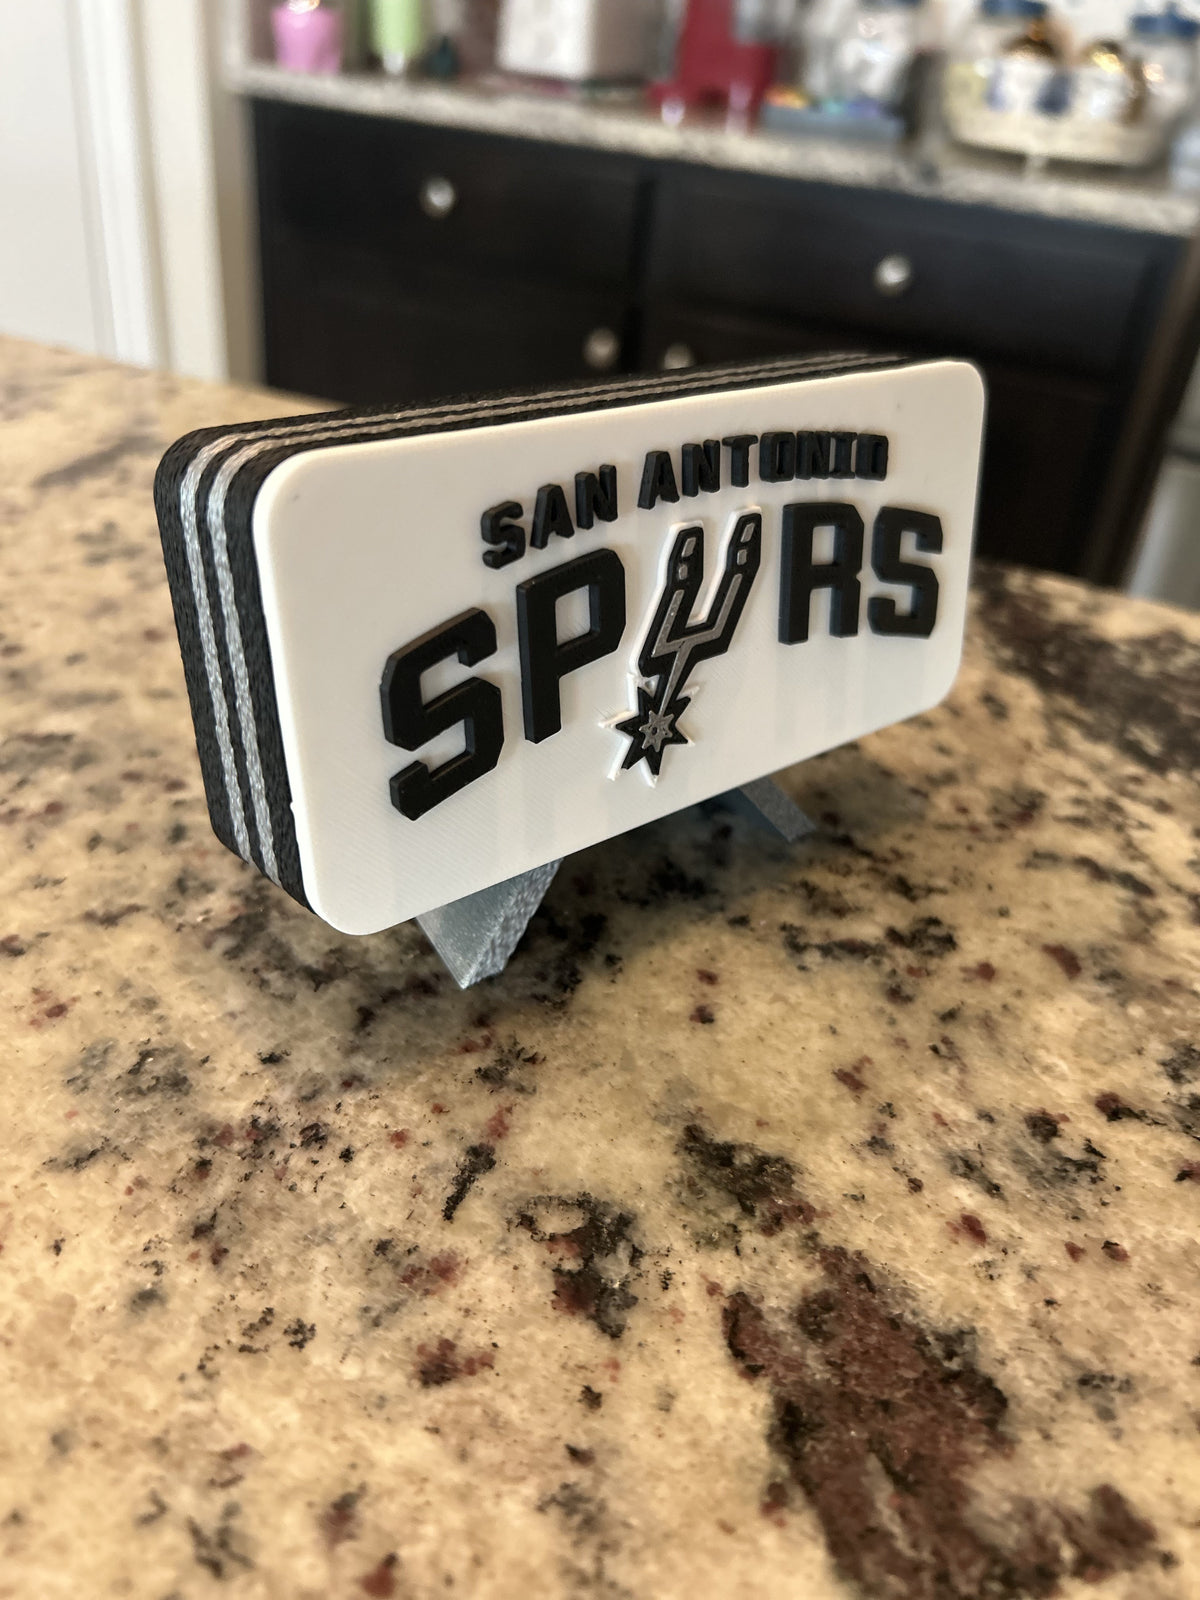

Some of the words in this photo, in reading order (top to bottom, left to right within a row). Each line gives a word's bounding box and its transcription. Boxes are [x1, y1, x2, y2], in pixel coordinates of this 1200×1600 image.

[480, 464, 618, 569] SAN
[637, 430, 888, 510] ANTONIO
[379, 502, 943, 821] SPURS
